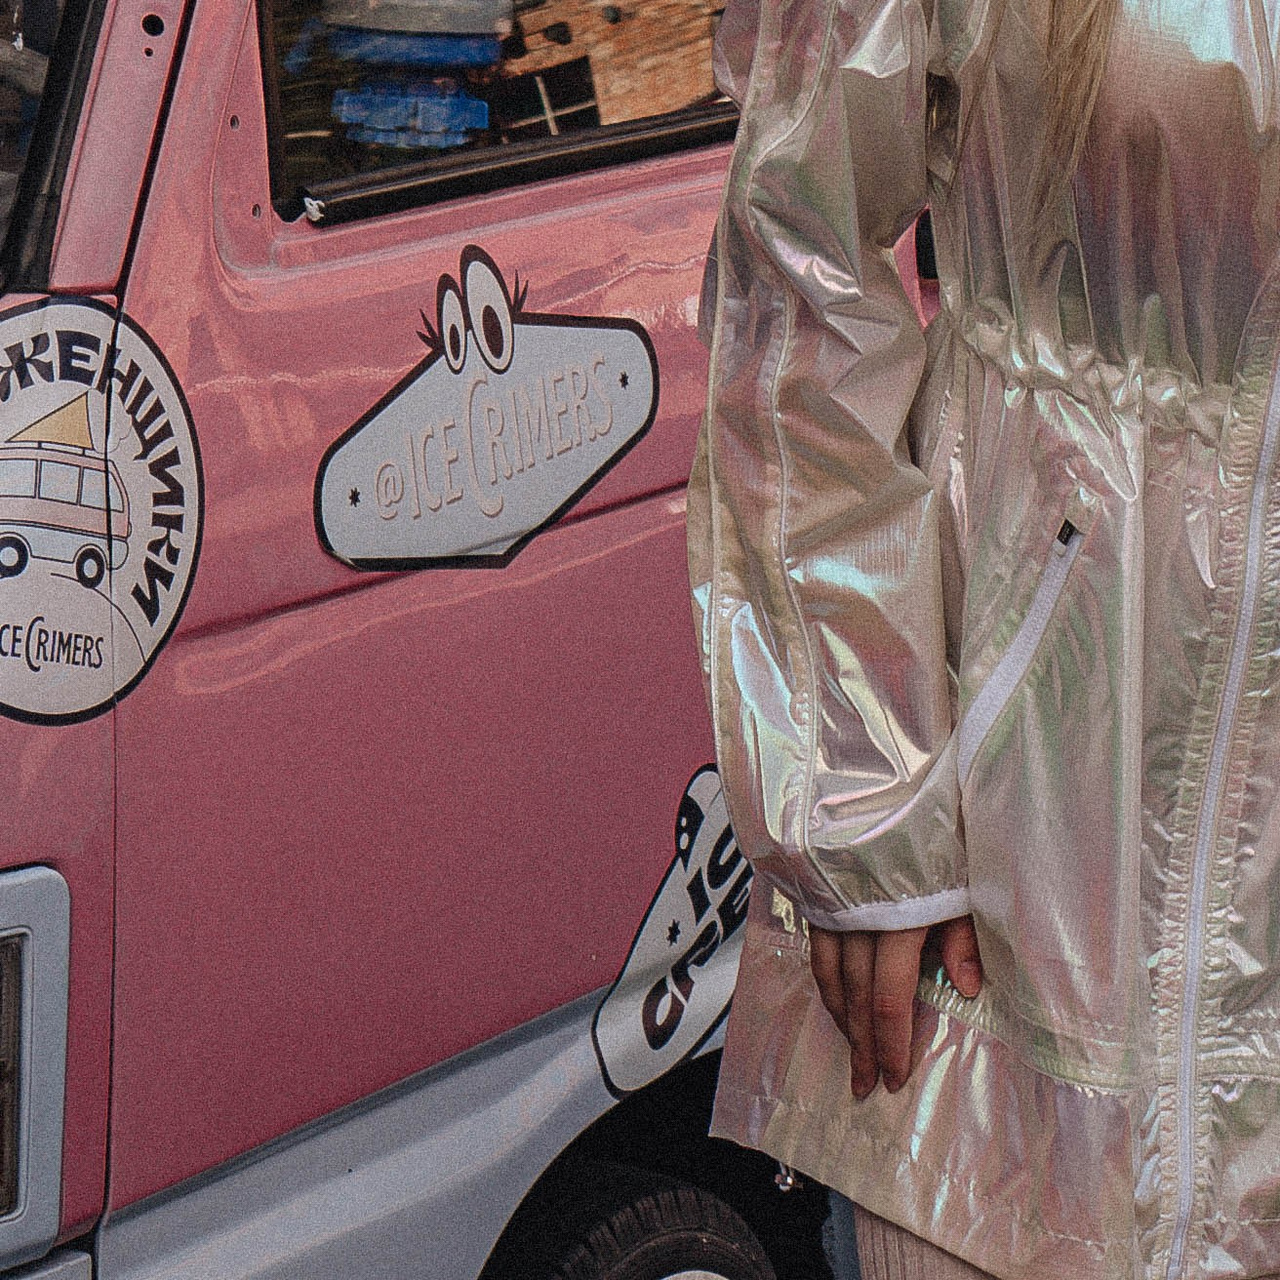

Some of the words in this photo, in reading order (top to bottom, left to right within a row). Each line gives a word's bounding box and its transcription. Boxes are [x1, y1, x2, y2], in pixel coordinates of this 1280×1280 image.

[374, 350, 614, 520] @ICECRIMERS
[641, 861, 754, 1051] CRE
[687, 823, 745, 926] IC
